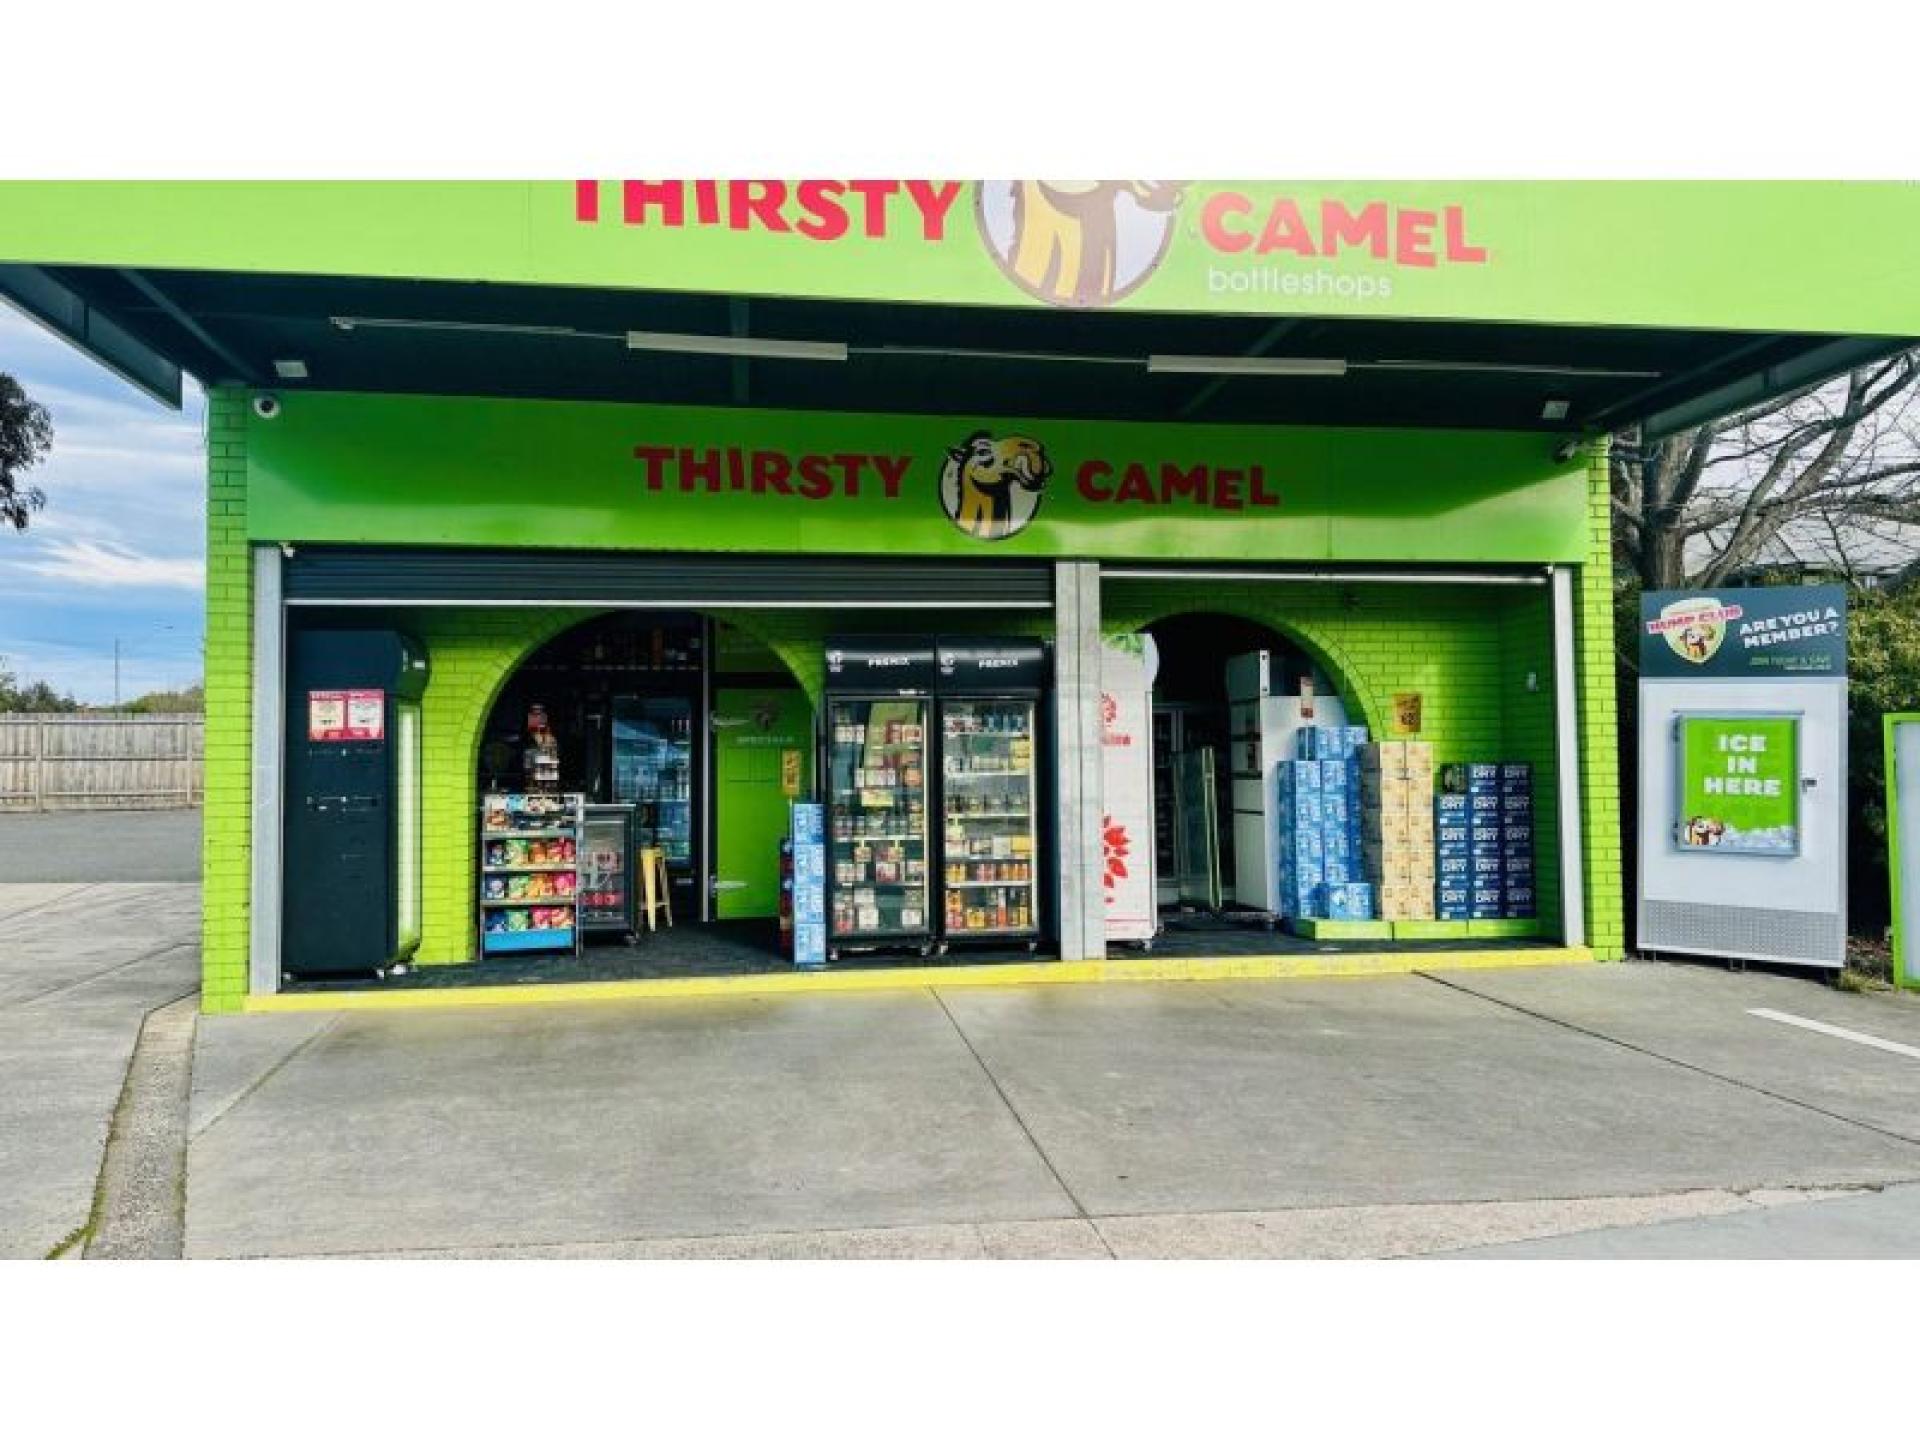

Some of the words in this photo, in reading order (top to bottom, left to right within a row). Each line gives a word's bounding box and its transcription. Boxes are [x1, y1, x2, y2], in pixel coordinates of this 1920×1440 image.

[1201, 191, 1487, 267] CAMEL
[1208, 265, 1392, 299] bottleshops
[634, 446, 911, 499] THIRSTY
[1076, 460, 1279, 511] CAMEL
[1739, 617, 1777, 637] ARE
[1778, 608, 1820, 628] YOU
[1824, 606, 1841, 620] A
[1744, 621, 1842, 649] MEMBER?
[1718, 734, 1768, 753] ICE
[1726, 755, 1758, 774] IN
[1703, 776, 1782, 797] HERE
